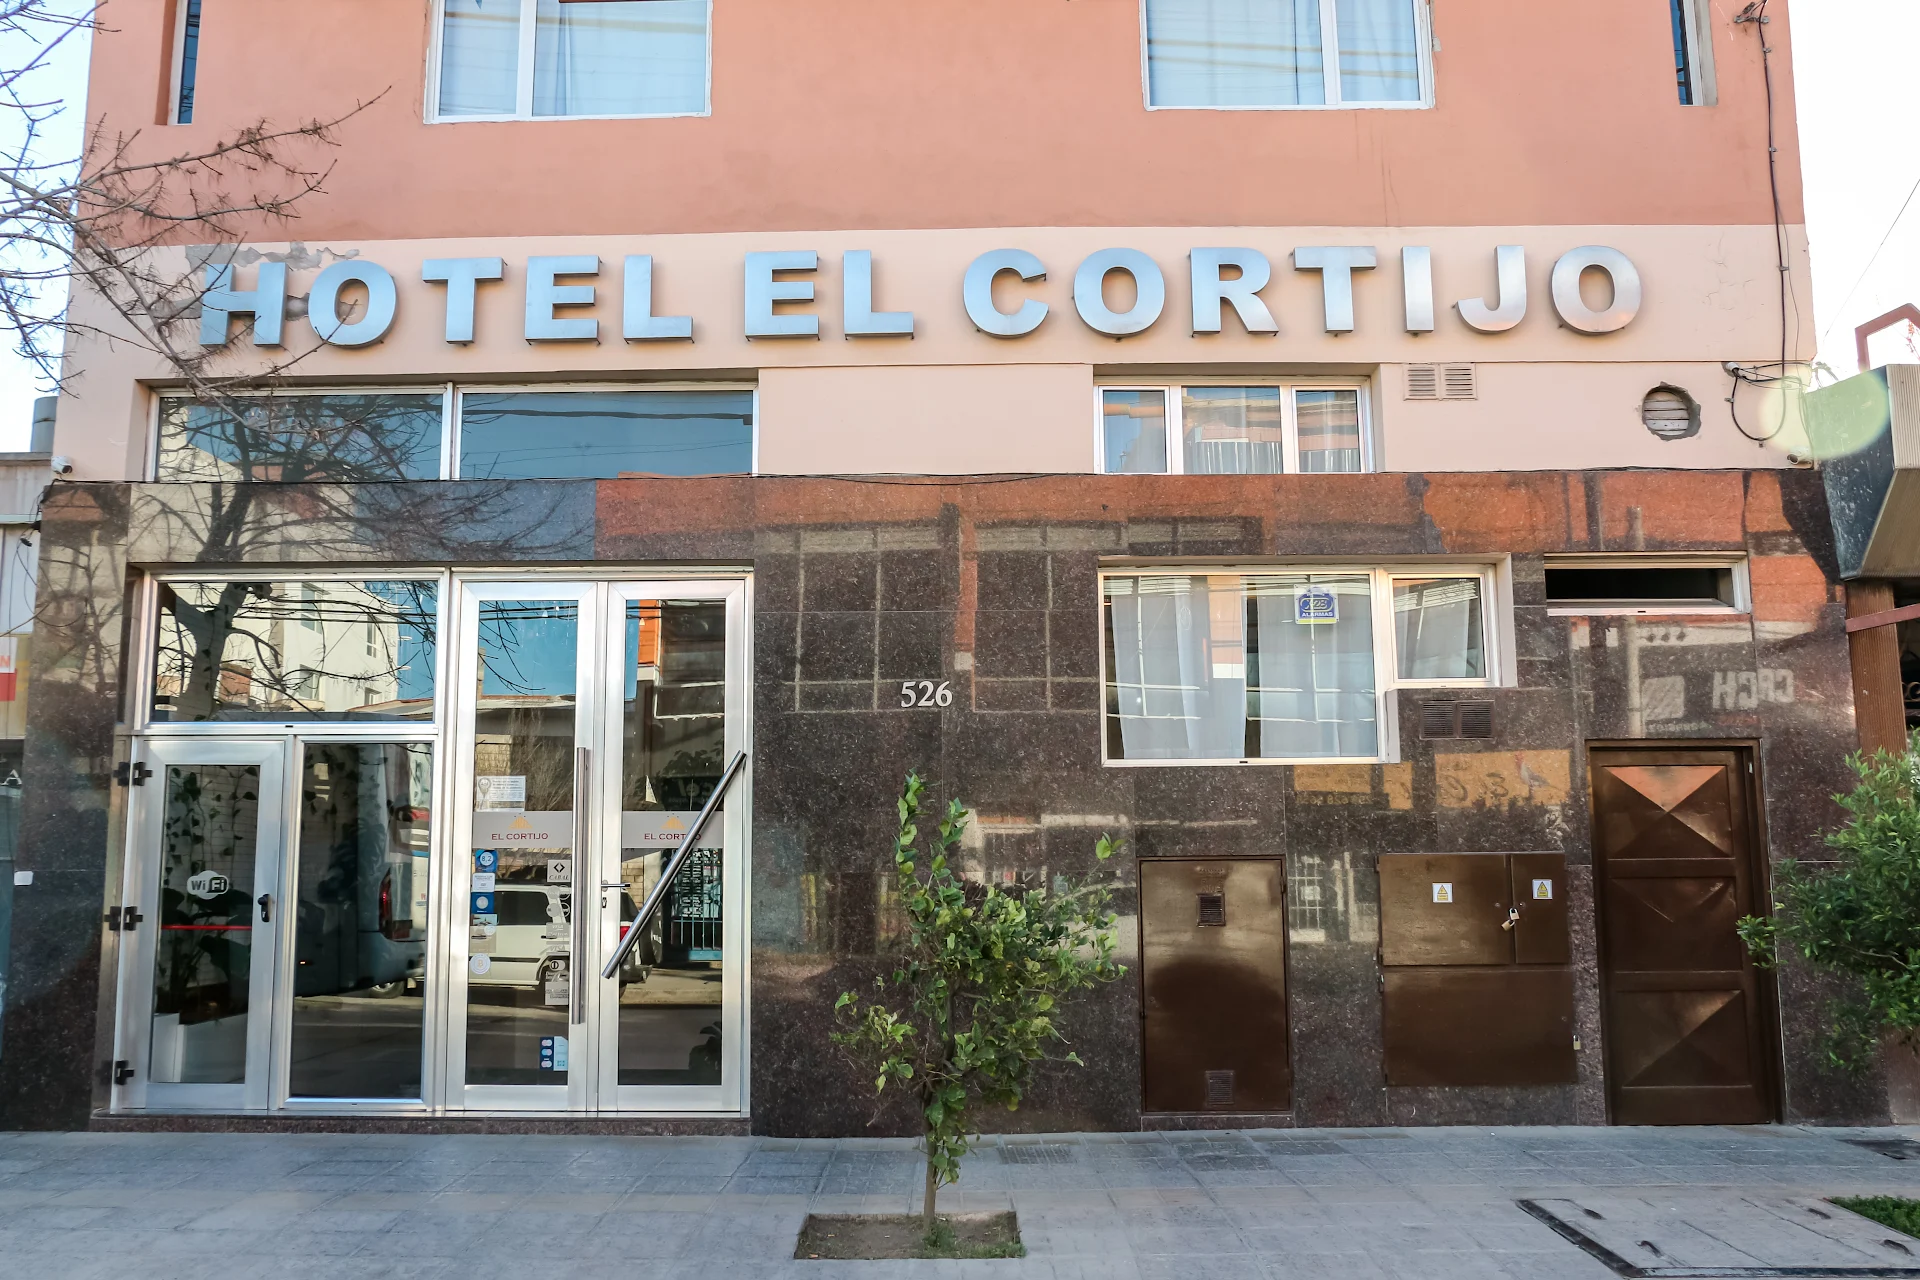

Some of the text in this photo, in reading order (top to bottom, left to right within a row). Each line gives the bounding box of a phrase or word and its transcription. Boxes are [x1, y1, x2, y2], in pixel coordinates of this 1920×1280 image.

[198, 244, 1643, 349] HOTEL EL CORTIJO
[901, 681, 953, 708] 526
[491, 833, 504, 841] EL
[481, 855, 492, 863] 8,2
[191, 879, 225, 891] WiFi
